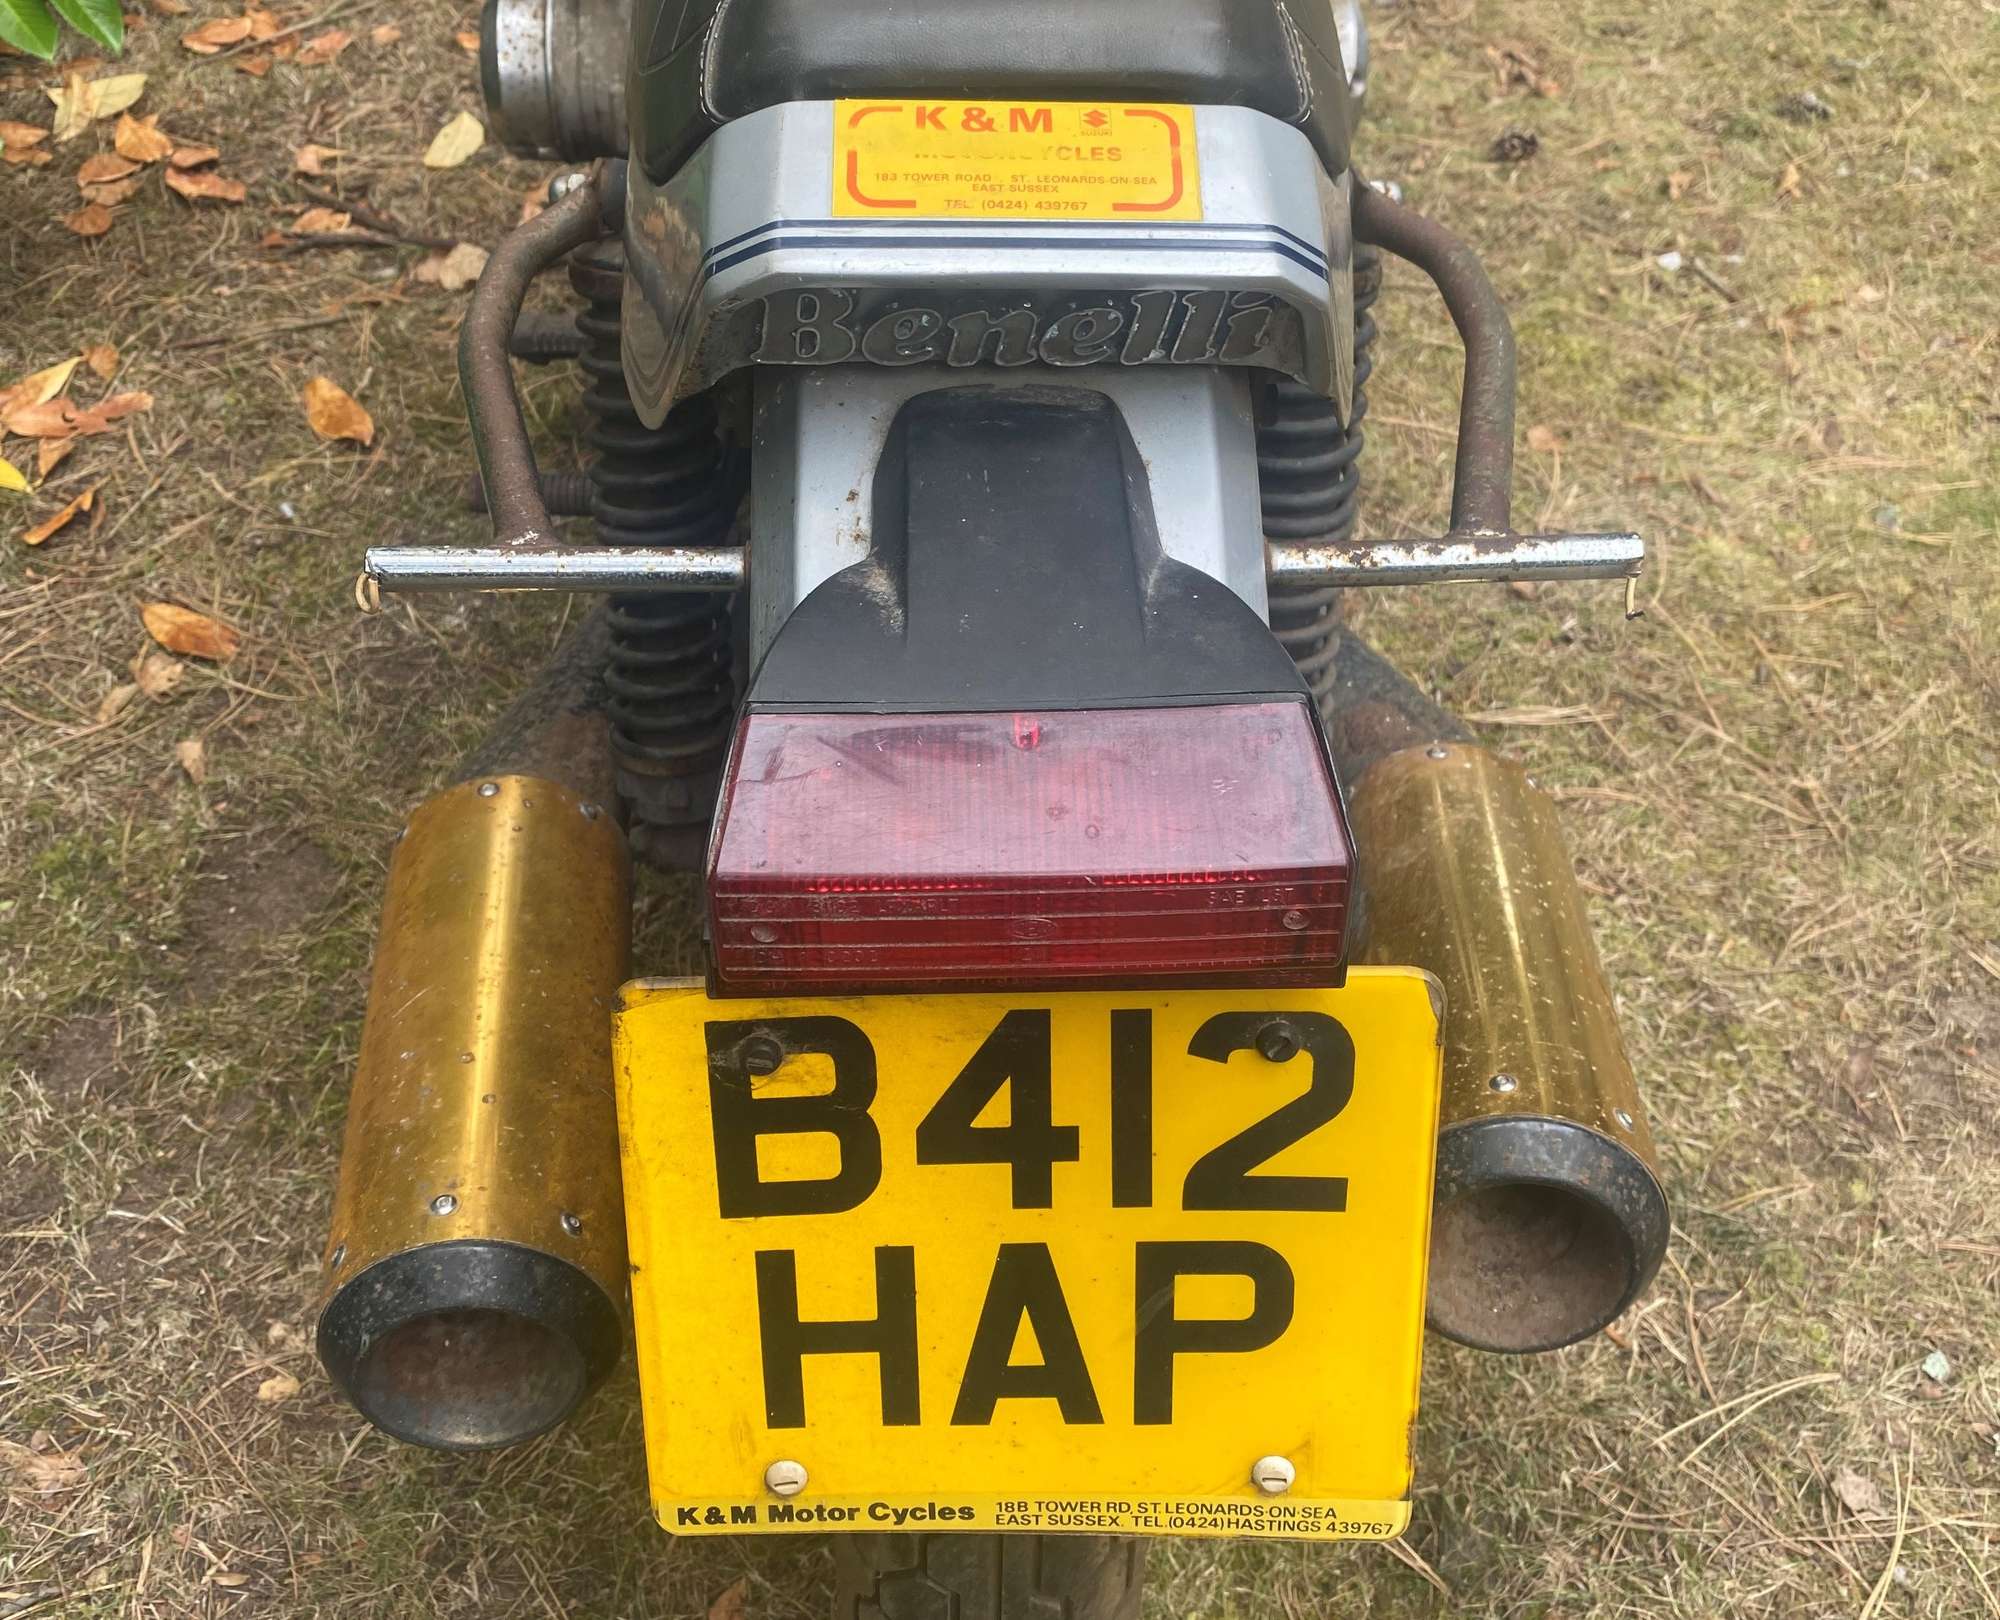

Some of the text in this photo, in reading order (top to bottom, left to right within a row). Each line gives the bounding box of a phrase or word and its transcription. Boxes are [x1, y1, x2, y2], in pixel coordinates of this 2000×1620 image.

[916, 106, 1053, 133] K & M
[904, 173, 949, 182] TOWER
[972, 184, 1059, 193] EAST SUSSEX
[982, 200, 1028, 211] (0424)
[1035, 201, 1088, 211] 439767
[750, 289, 1277, 367] Benelli
[704, 1008, 1357, 1219] B412
[755, 1240, 1295, 1429] HAP
[768, 1504, 860, 1523] Motor
[867, 1502, 976, 1526] Cycles
[1035, 1502, 1101, 1514] TOWER
[995, 1514, 1042, 1526] EAST
[1228, 1517, 1321, 1533] HASTINGS
[1326, 1521, 1394, 1536] 439767
